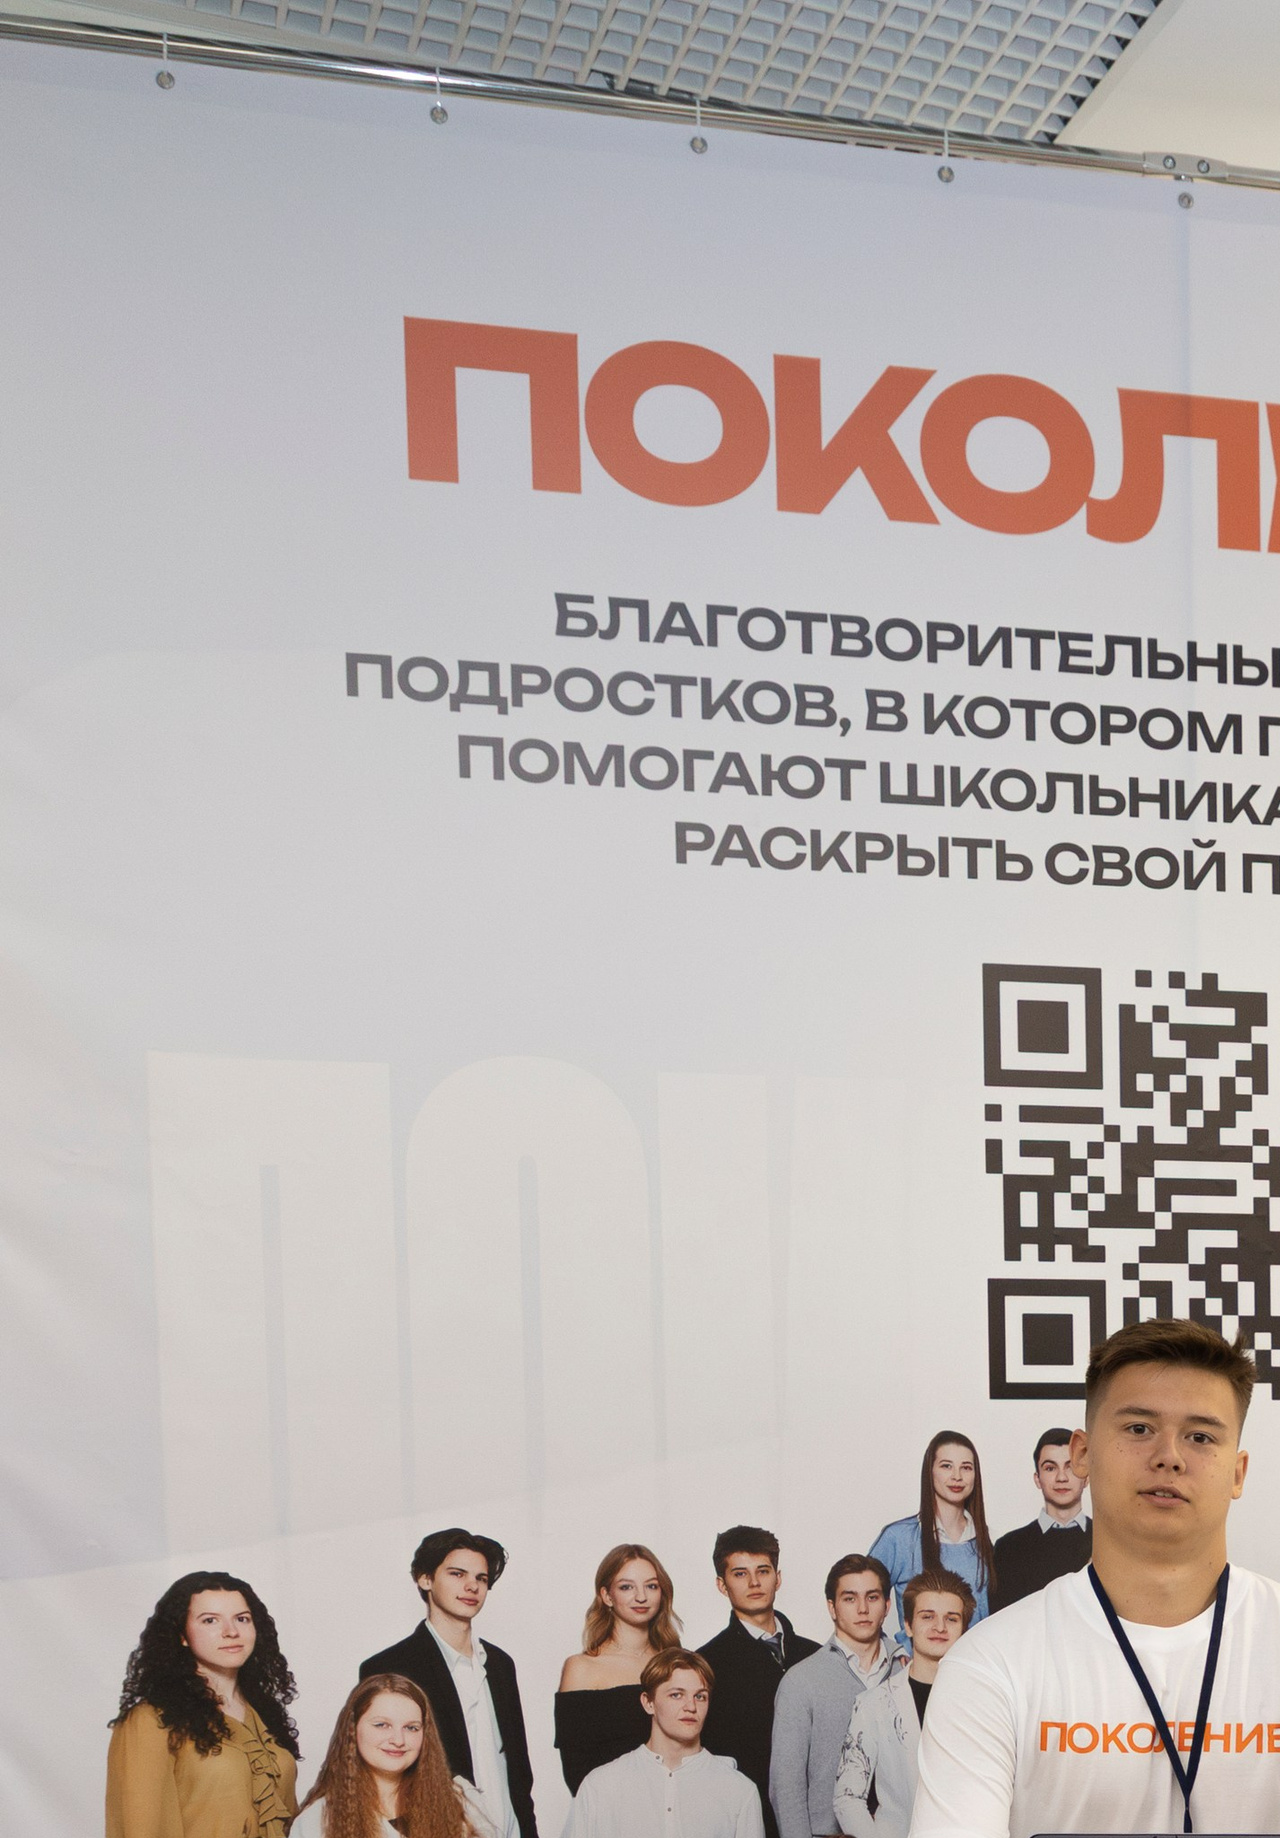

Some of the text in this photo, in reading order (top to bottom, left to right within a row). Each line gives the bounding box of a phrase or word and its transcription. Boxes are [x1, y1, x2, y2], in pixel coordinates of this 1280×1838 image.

[345, 652, 853, 737] ПОДРОСТКОВ,
[864, 688, 909, 733] В
[923, 692, 1243, 755] КОТОРОМ
[457, 735, 867, 802] ПОМОГАЮТ
[674, 821, 1034, 883] РАСКРЫТЬ
[1044, 838, 1227, 893] СВОЙ
